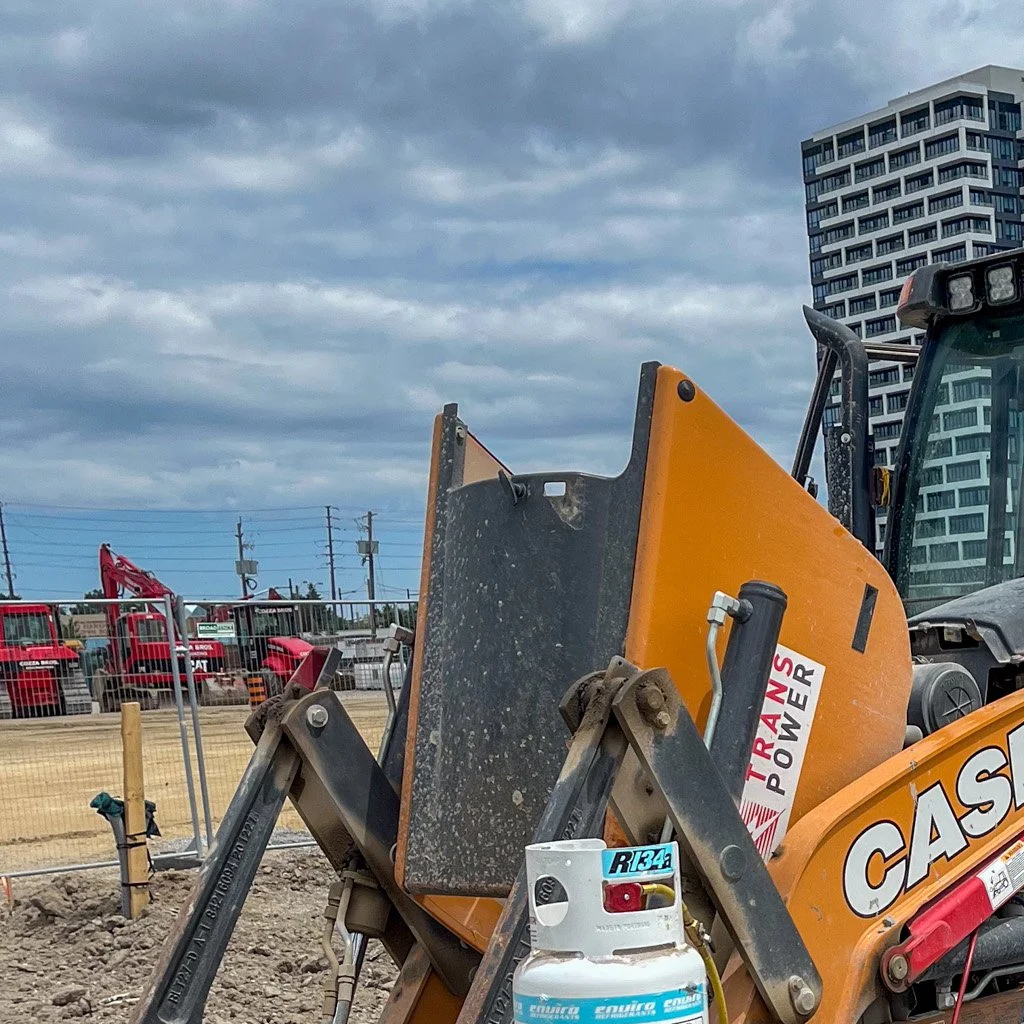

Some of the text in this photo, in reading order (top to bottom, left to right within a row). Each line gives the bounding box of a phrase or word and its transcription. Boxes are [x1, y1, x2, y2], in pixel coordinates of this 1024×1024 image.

[745, 653, 794, 783] TRANS
[766, 663, 814, 796] POWER
[609, 848, 672, 874] R134a
[530, 1003, 580, 1014] enviro
[594, 1000, 656, 1014] enviro
